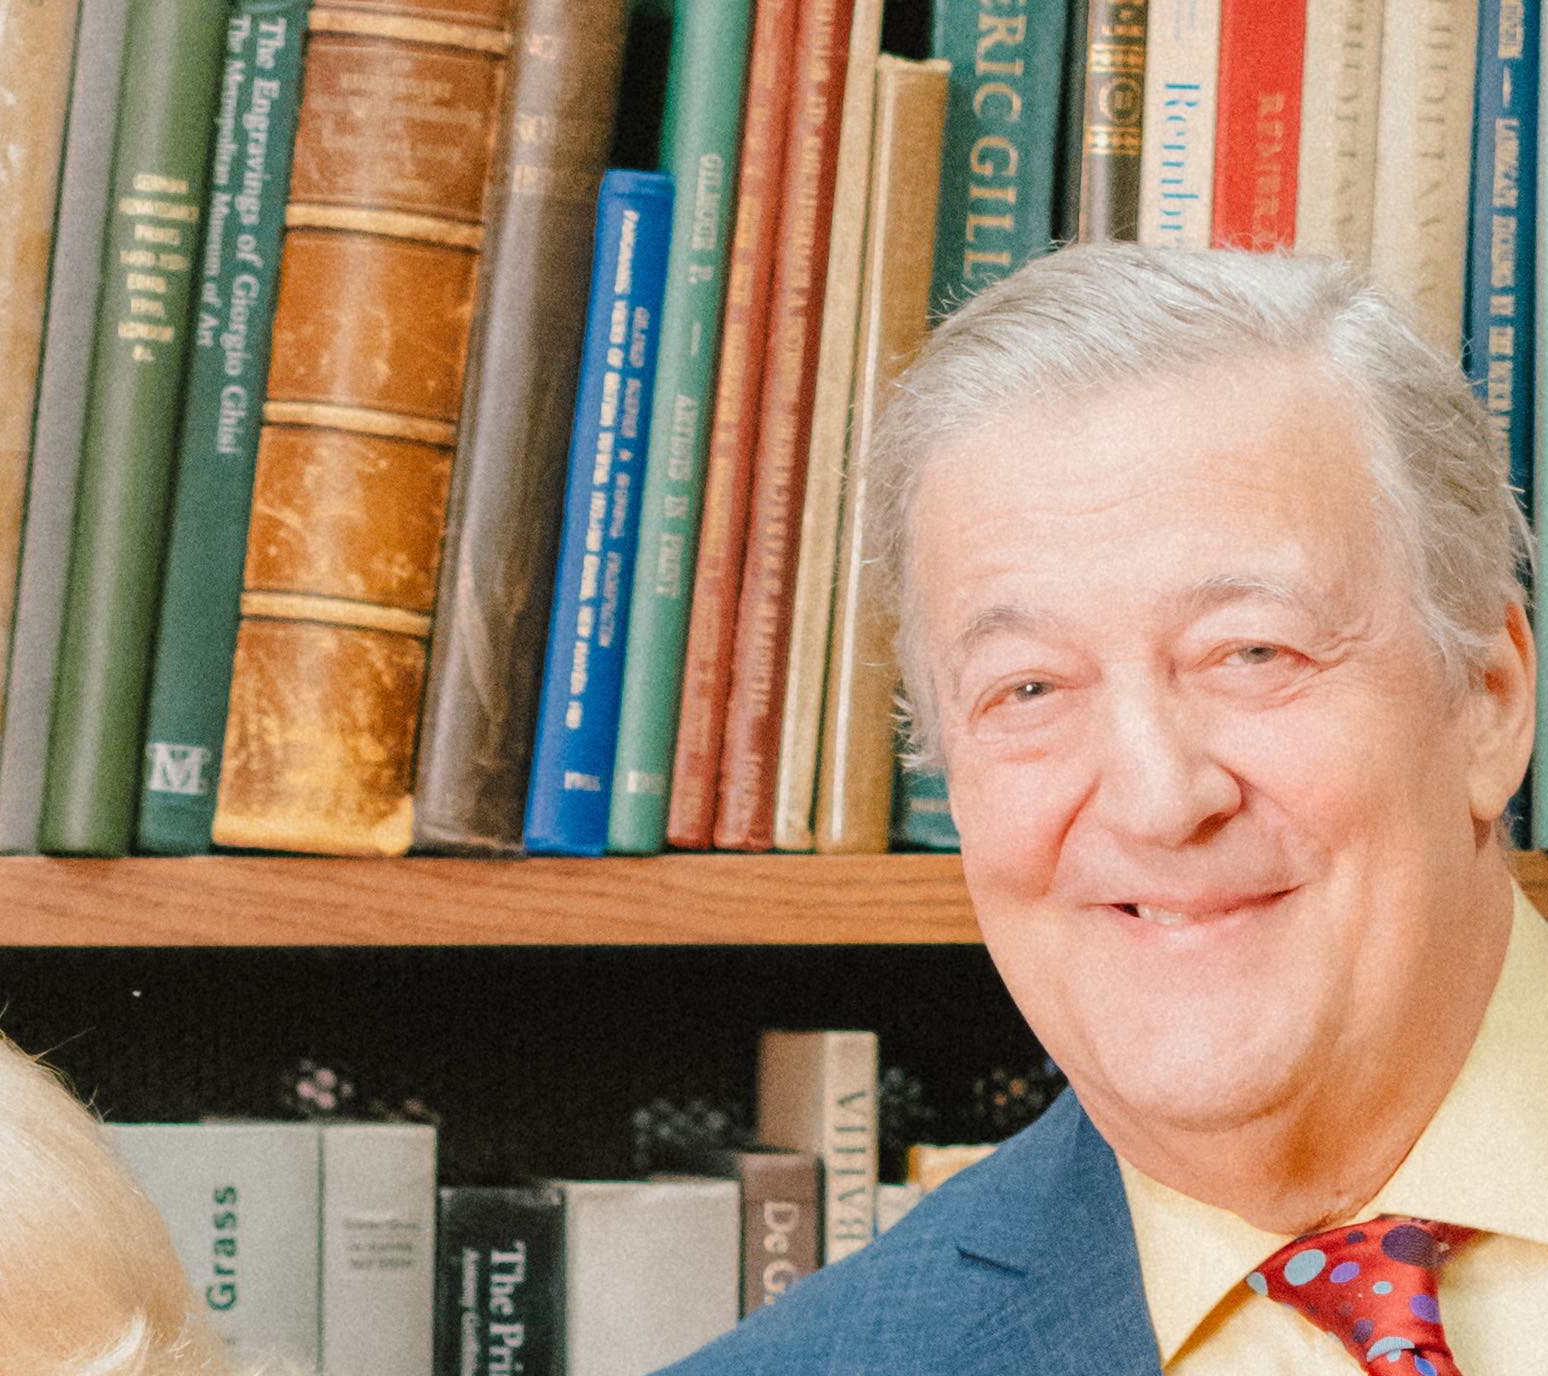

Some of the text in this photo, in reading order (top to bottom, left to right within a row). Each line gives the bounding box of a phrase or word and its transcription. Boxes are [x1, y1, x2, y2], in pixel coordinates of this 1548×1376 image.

[197, 15, 252, 347] The Metropolitan Museum of Art
[691, 153, 725, 251] GILMOUR
[964, 136, 1021, 281] GILL
[216, 18, 287, 454] The Engravings of Giorgio Ghisi
[667, 394, 699, 481] ARTISTS
[654, 533, 684, 598] PRINT
[205, 1185, 238, 1312] Grass
[764, 1200, 800, 1254] De
[489, 1240, 528, 1315] The
